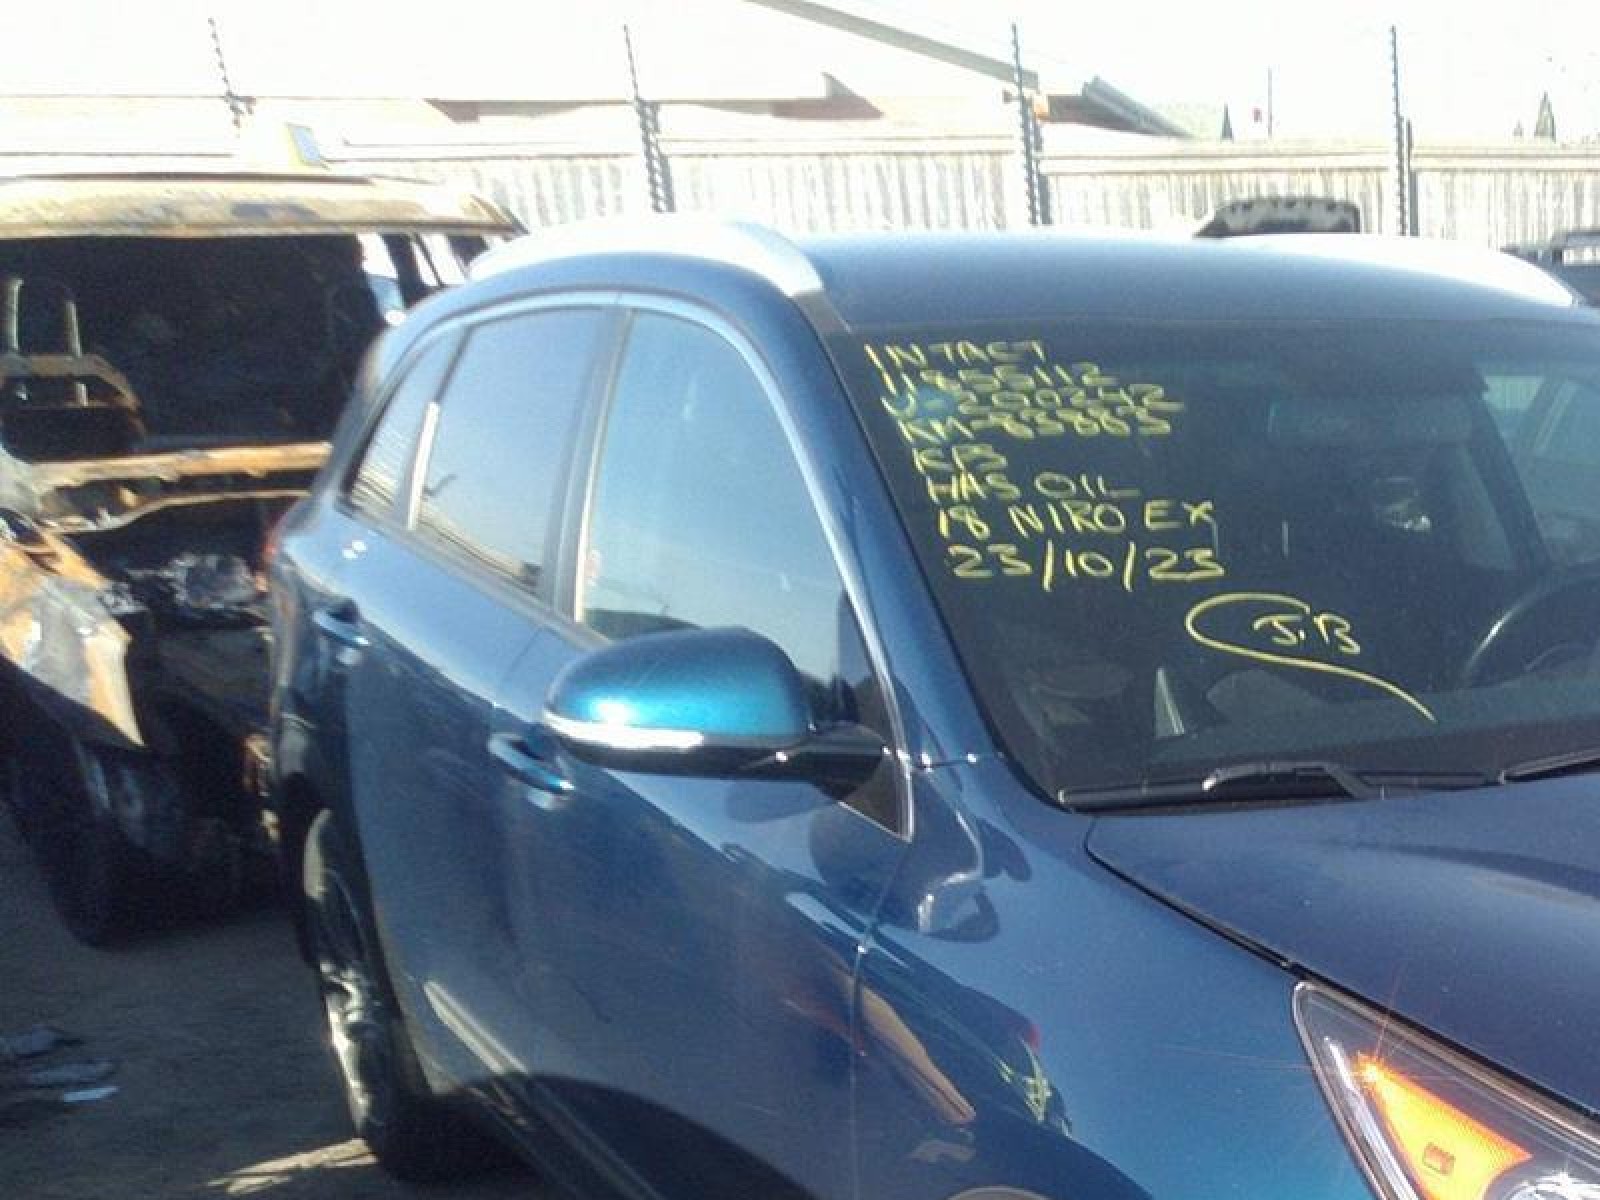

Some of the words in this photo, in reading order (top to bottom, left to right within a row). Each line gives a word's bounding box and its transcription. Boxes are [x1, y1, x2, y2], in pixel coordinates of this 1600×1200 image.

[926, 472, 1022, 503] HAS
[1033, 471, 1141, 500] OIL
[938, 504, 991, 540] 18
[1007, 498, 1127, 539] NIRO
[1142, 498, 1214, 531] EX
[947, 538, 1226, 594] 23/10/23
